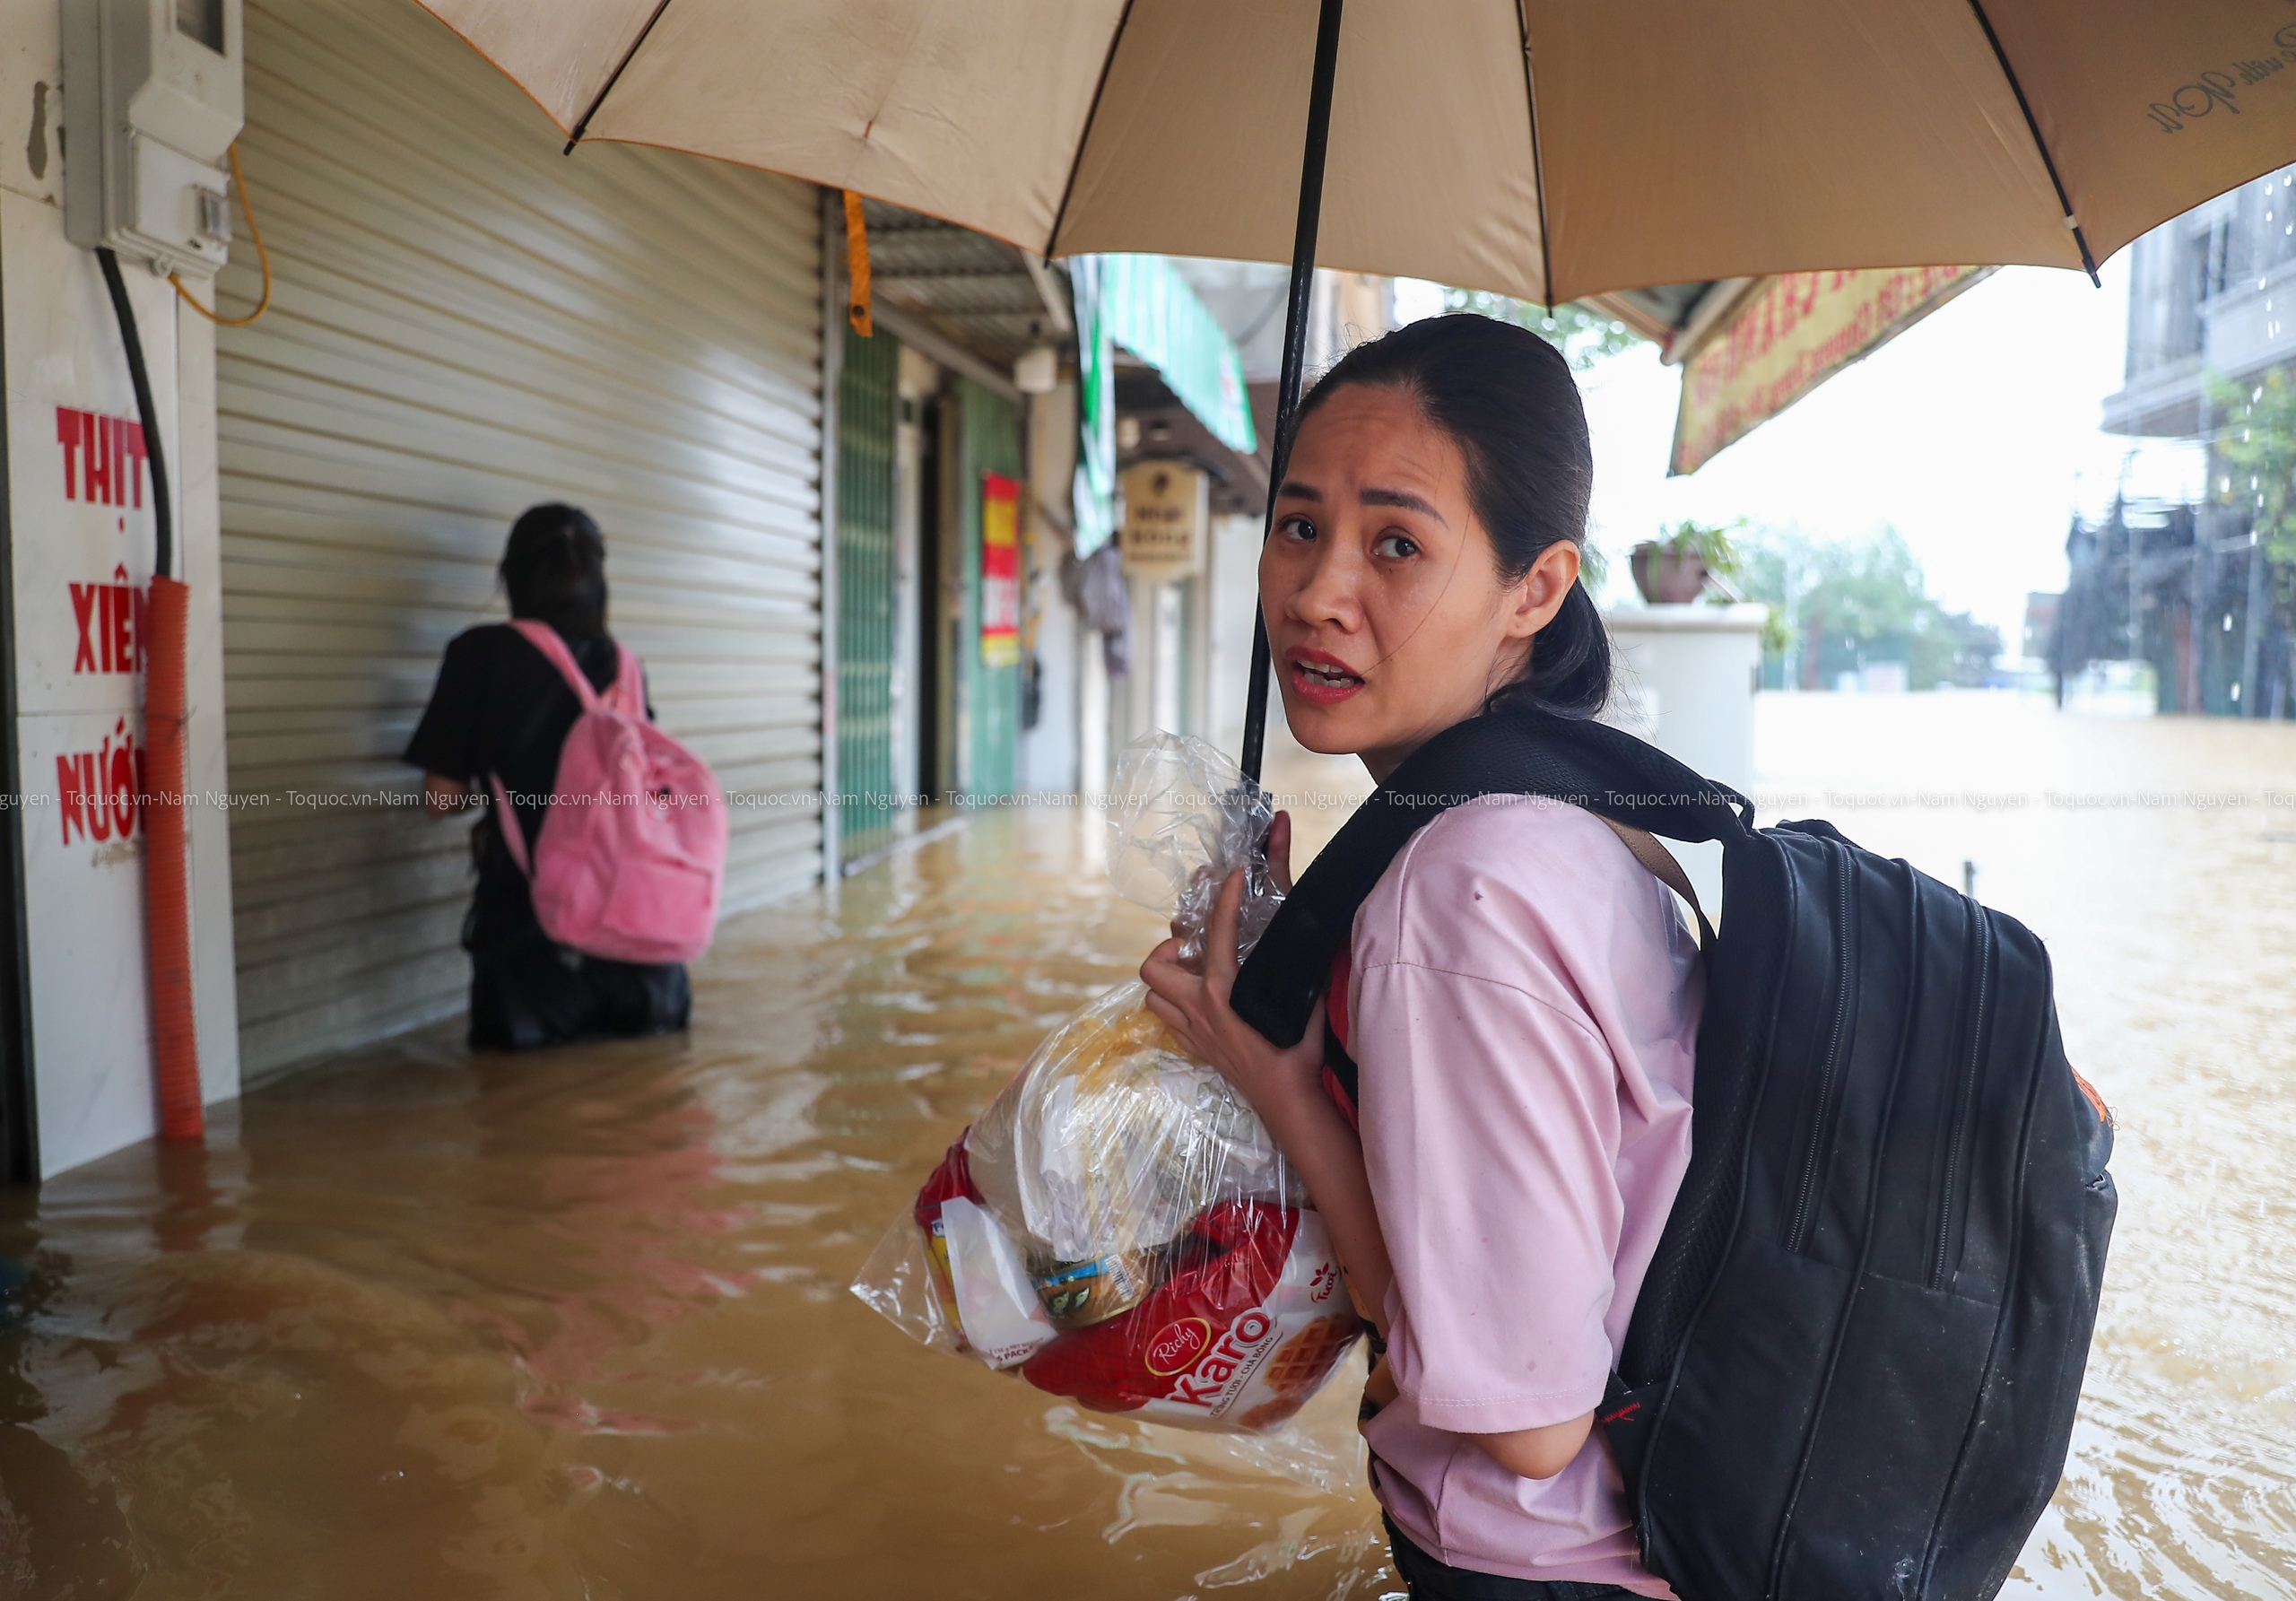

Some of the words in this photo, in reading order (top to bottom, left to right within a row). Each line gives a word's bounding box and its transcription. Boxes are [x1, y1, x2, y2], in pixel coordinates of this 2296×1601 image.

[56, 406, 151, 534] THỊT
[1152, 1323, 1201, 1365] Richy
[1169, 1310, 1272, 1408] Karo
